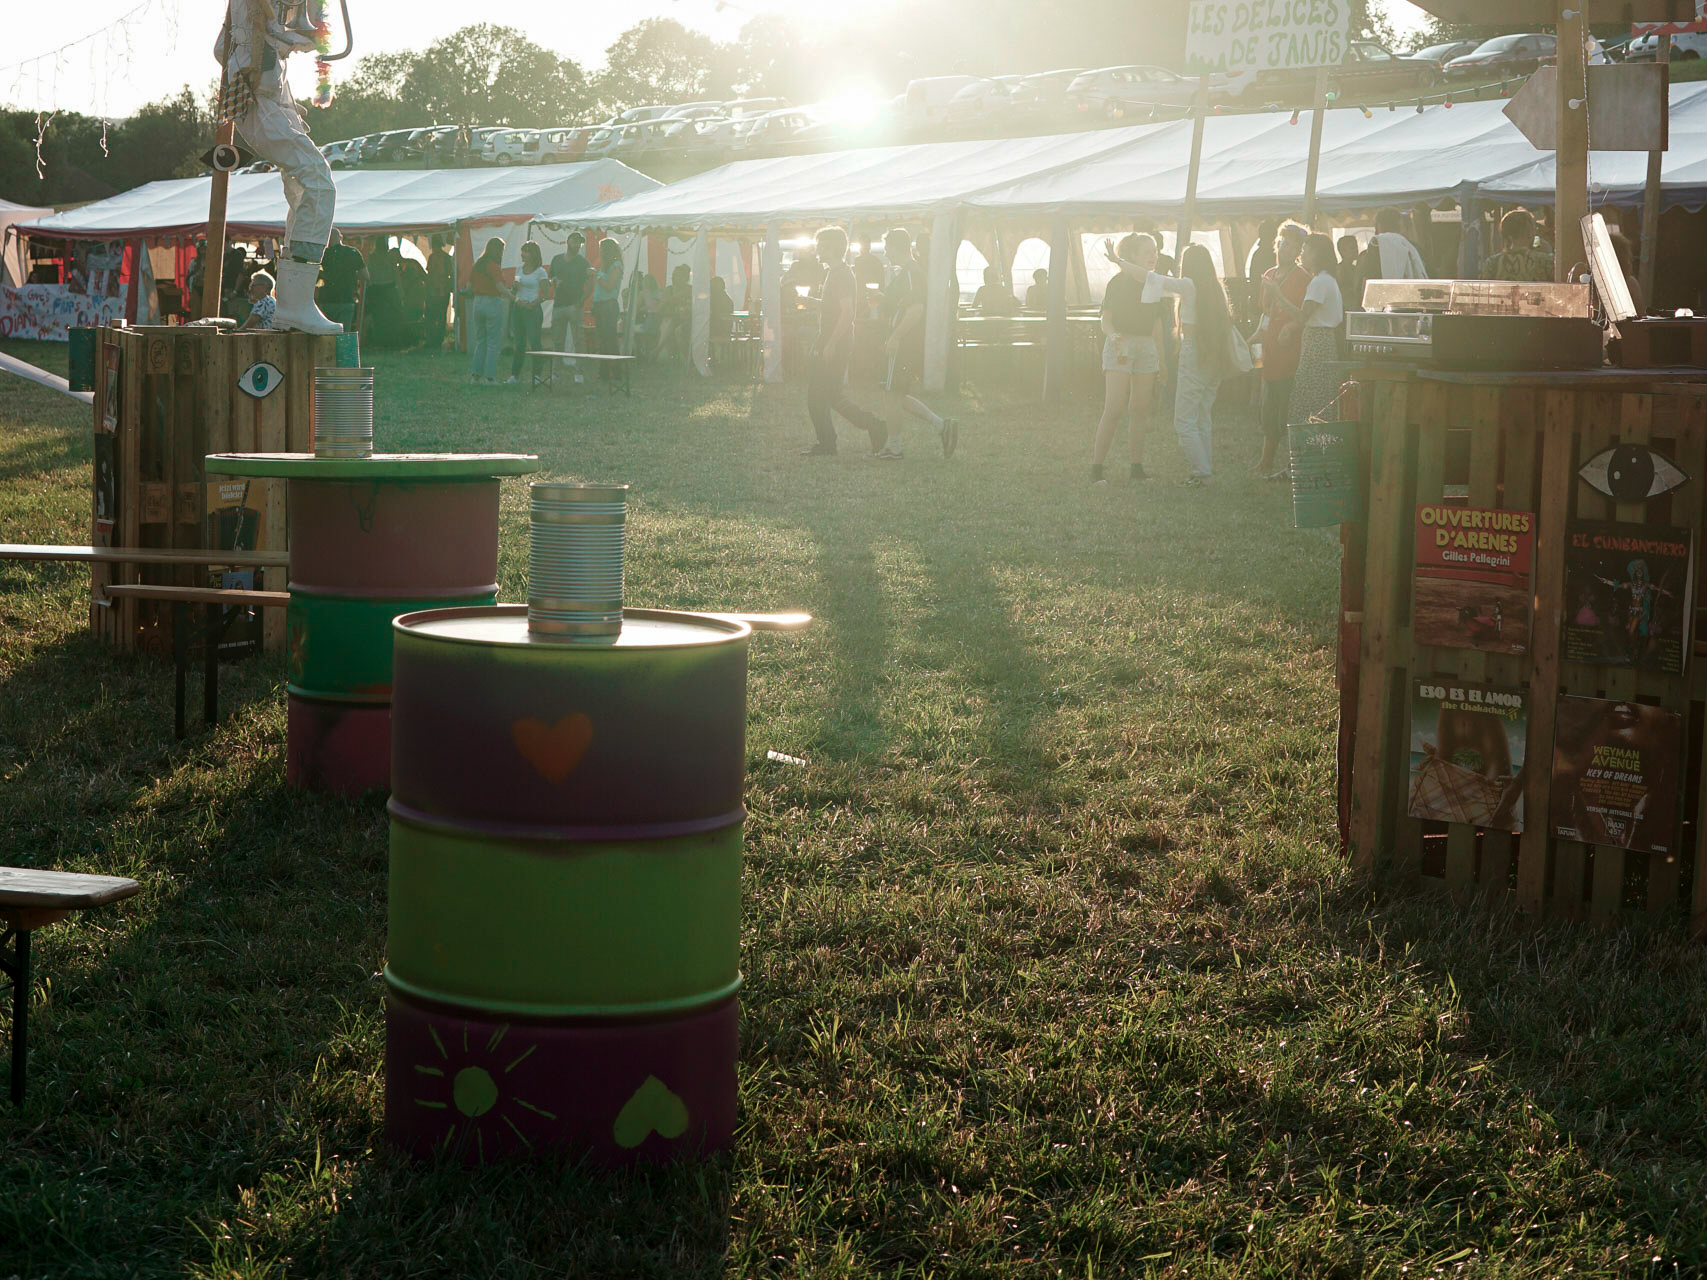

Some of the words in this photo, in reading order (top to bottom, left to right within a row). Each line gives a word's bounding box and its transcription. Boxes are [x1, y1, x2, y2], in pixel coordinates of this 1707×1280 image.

[1191, 3, 1228, 36] LES
[1229, 36, 1259, 66] DE
[1421, 507, 1529, 532] OUVERTURES
[1436, 528, 1517, 553] D'ARENES
[1572, 533, 1590, 548] EL
[1593, 536, 1686, 557] CUMBANCHERO
[1442, 551, 1468, 562] Gilles
[1470, 553, 1510, 567] Pellegrini
[1420, 685, 1446, 699] ESO
[1449, 688, 1465, 701] ES
[1468, 689, 1483, 703] EL
[1485, 691, 1522, 708] AMOR
[1441, 701, 1457, 710] the
[1460, 703, 1506, 715] Chakachas
[1591, 755, 1640, 772] AVENUE
[1593, 745, 1640, 760] WEYMAN
[1586, 768, 1602, 778] KEY
[1603, 771, 1613, 779] OF
[1613, 772, 1643, 784] DREAMS
